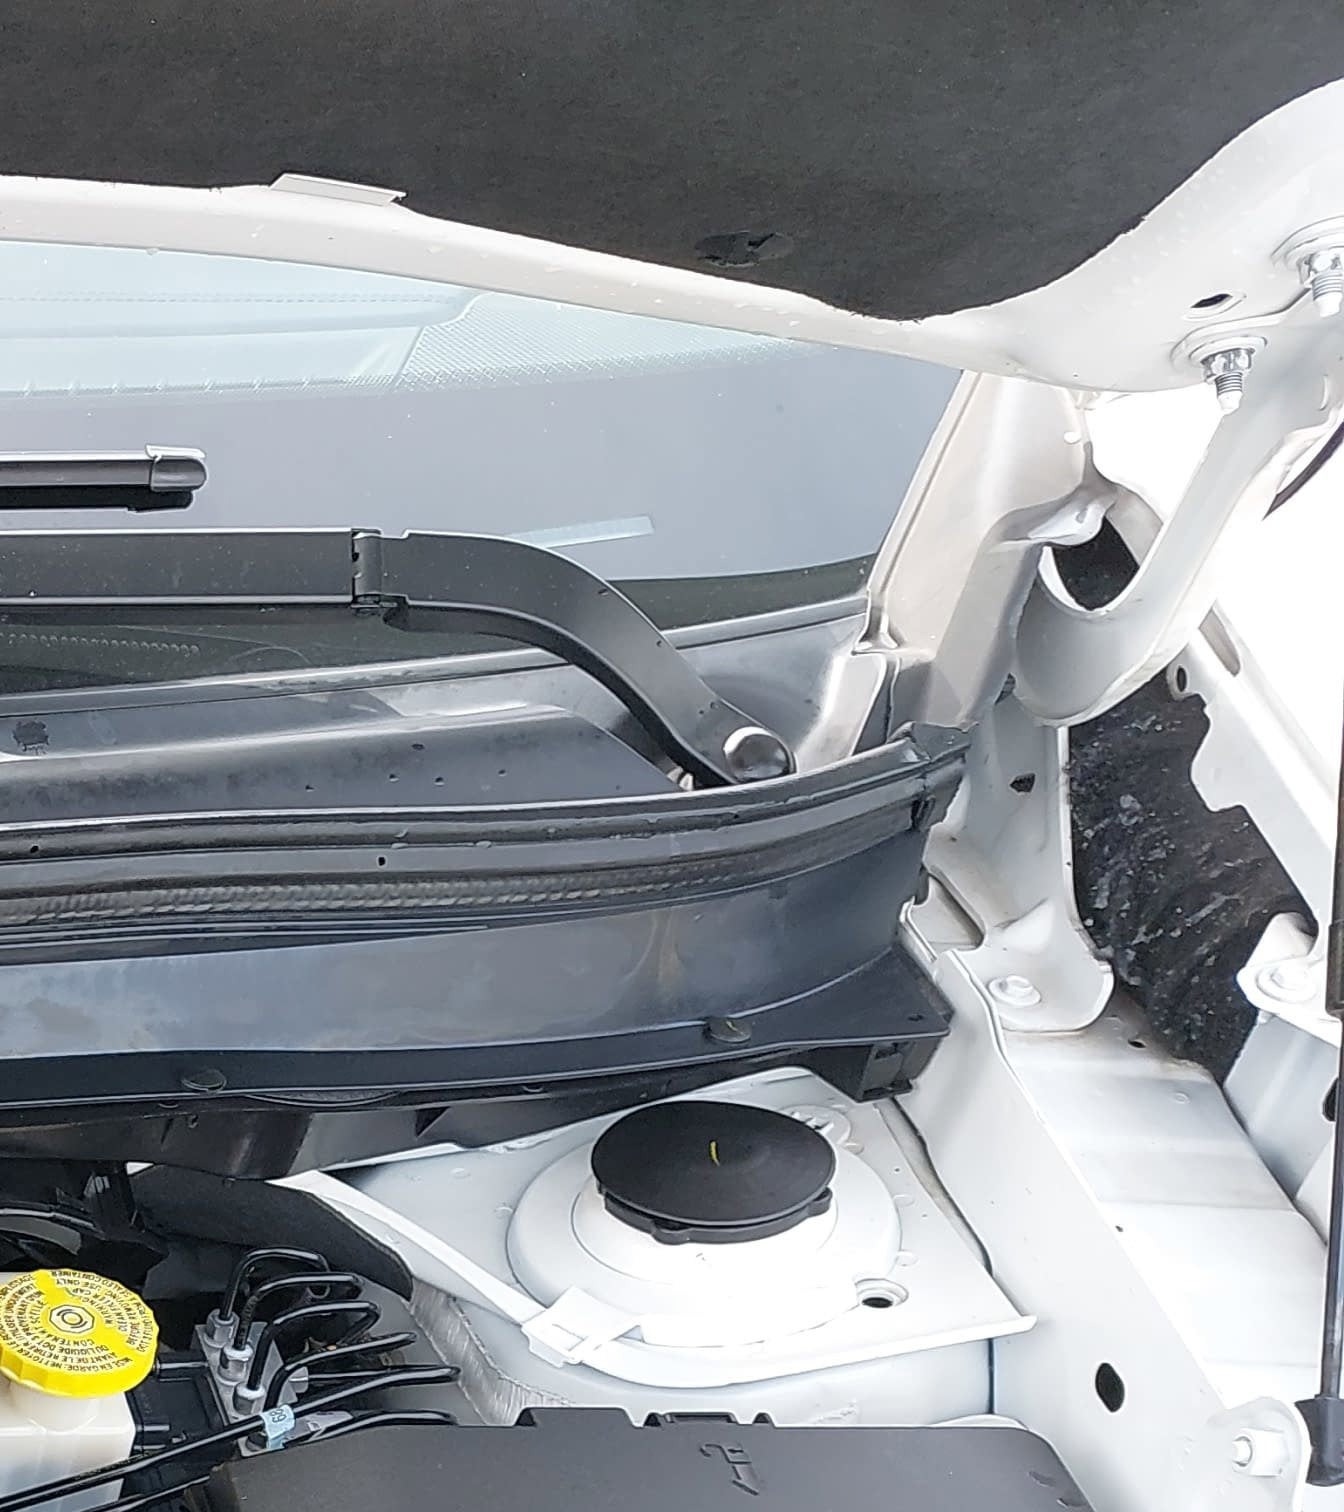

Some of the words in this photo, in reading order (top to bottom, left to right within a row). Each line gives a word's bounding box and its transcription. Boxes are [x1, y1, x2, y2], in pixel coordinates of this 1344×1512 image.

[50, 1271, 102, 1282] CONTAINER
[59, 1346, 96, 1356] LIQUIDE
[17, 1348, 62, 1370] NETTOYER
